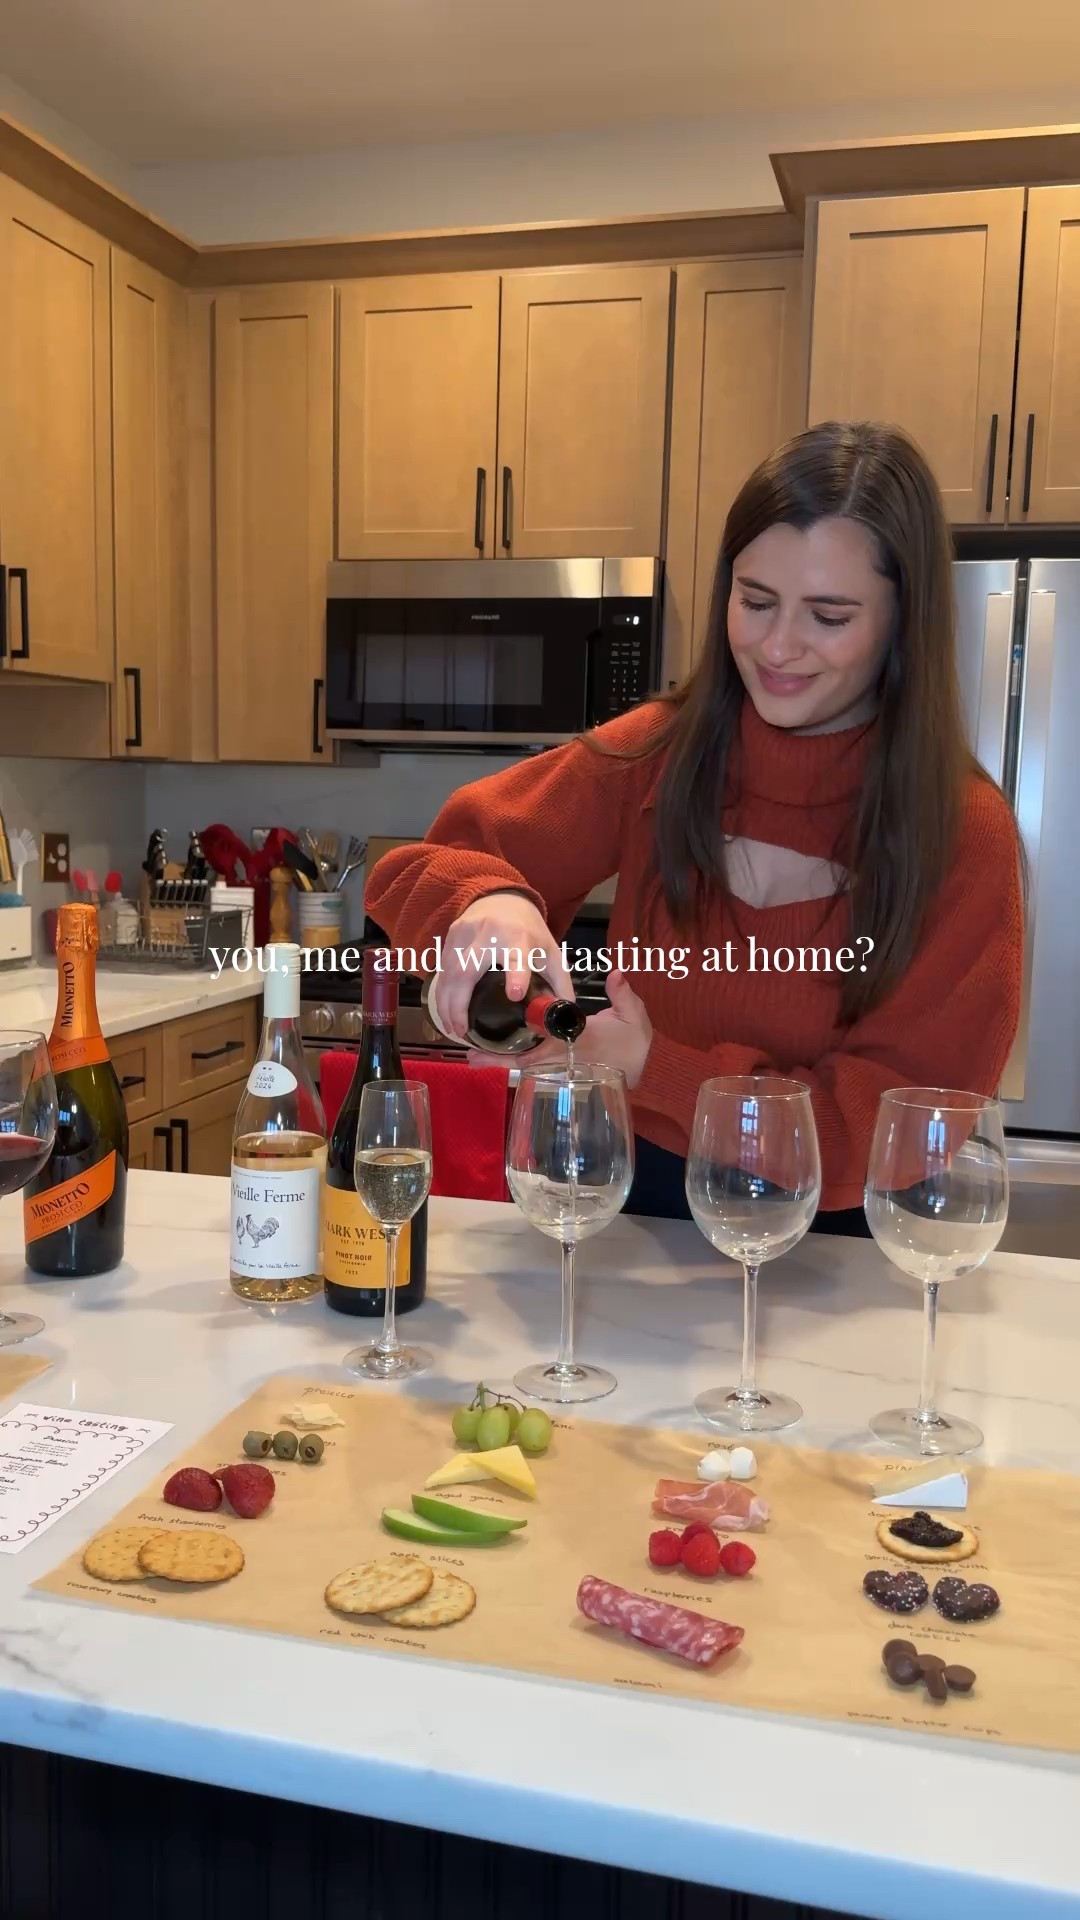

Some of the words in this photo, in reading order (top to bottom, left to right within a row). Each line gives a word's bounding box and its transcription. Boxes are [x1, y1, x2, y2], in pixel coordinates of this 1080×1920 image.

[264, 1189, 306, 1203] Ferme
[41, 1200, 83, 1224] PROSECCO
[354, 1228, 386, 1240] WES
[335, 1250, 352, 1260] PINOT
[354, 1254, 373, 1262] NOIR
[301, 1386, 356, 1400] prosecco
[43, 1415, 73, 1424] wine
[78, 1419, 129, 1432] tasting
[137, 1513, 164, 1522] fresh
[429, 1555, 465, 1567] slices
[643, 1586, 713, 1604] raspberries
[319, 1628, 342, 1636] red
